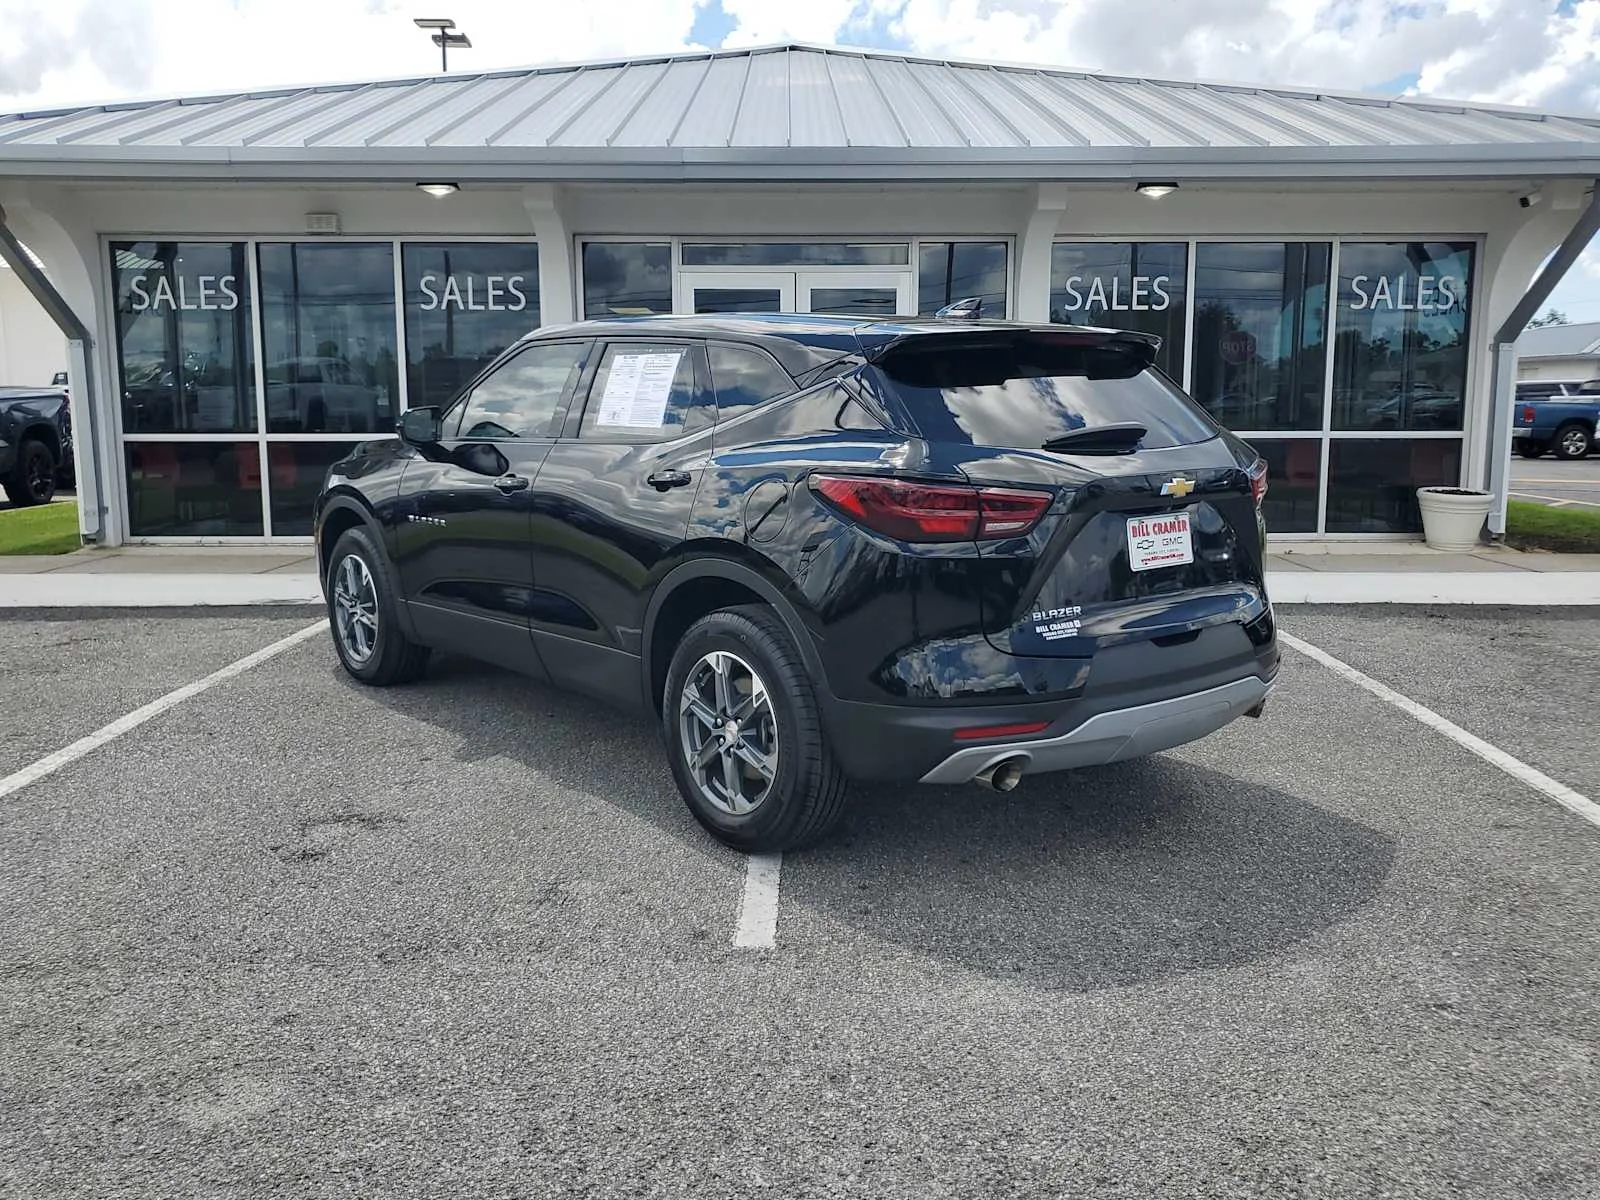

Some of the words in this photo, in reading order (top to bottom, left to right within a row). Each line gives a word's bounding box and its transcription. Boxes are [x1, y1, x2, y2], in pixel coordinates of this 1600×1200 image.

[130, 275, 239, 311] SALES
[419, 275, 527, 311] SALES
[1063, 275, 1171, 311] SALES
[1349, 275, 1457, 310] SALES
[1131, 523, 1151, 538] BILL
[1152, 519, 1188, 535] CRAMER
[1162, 536, 1184, 546] GMC
[1032, 605, 1082, 621] BLAZER
[1035, 625, 1050, 633] BILL
[1050, 621, 1075, 631] CRAMER
